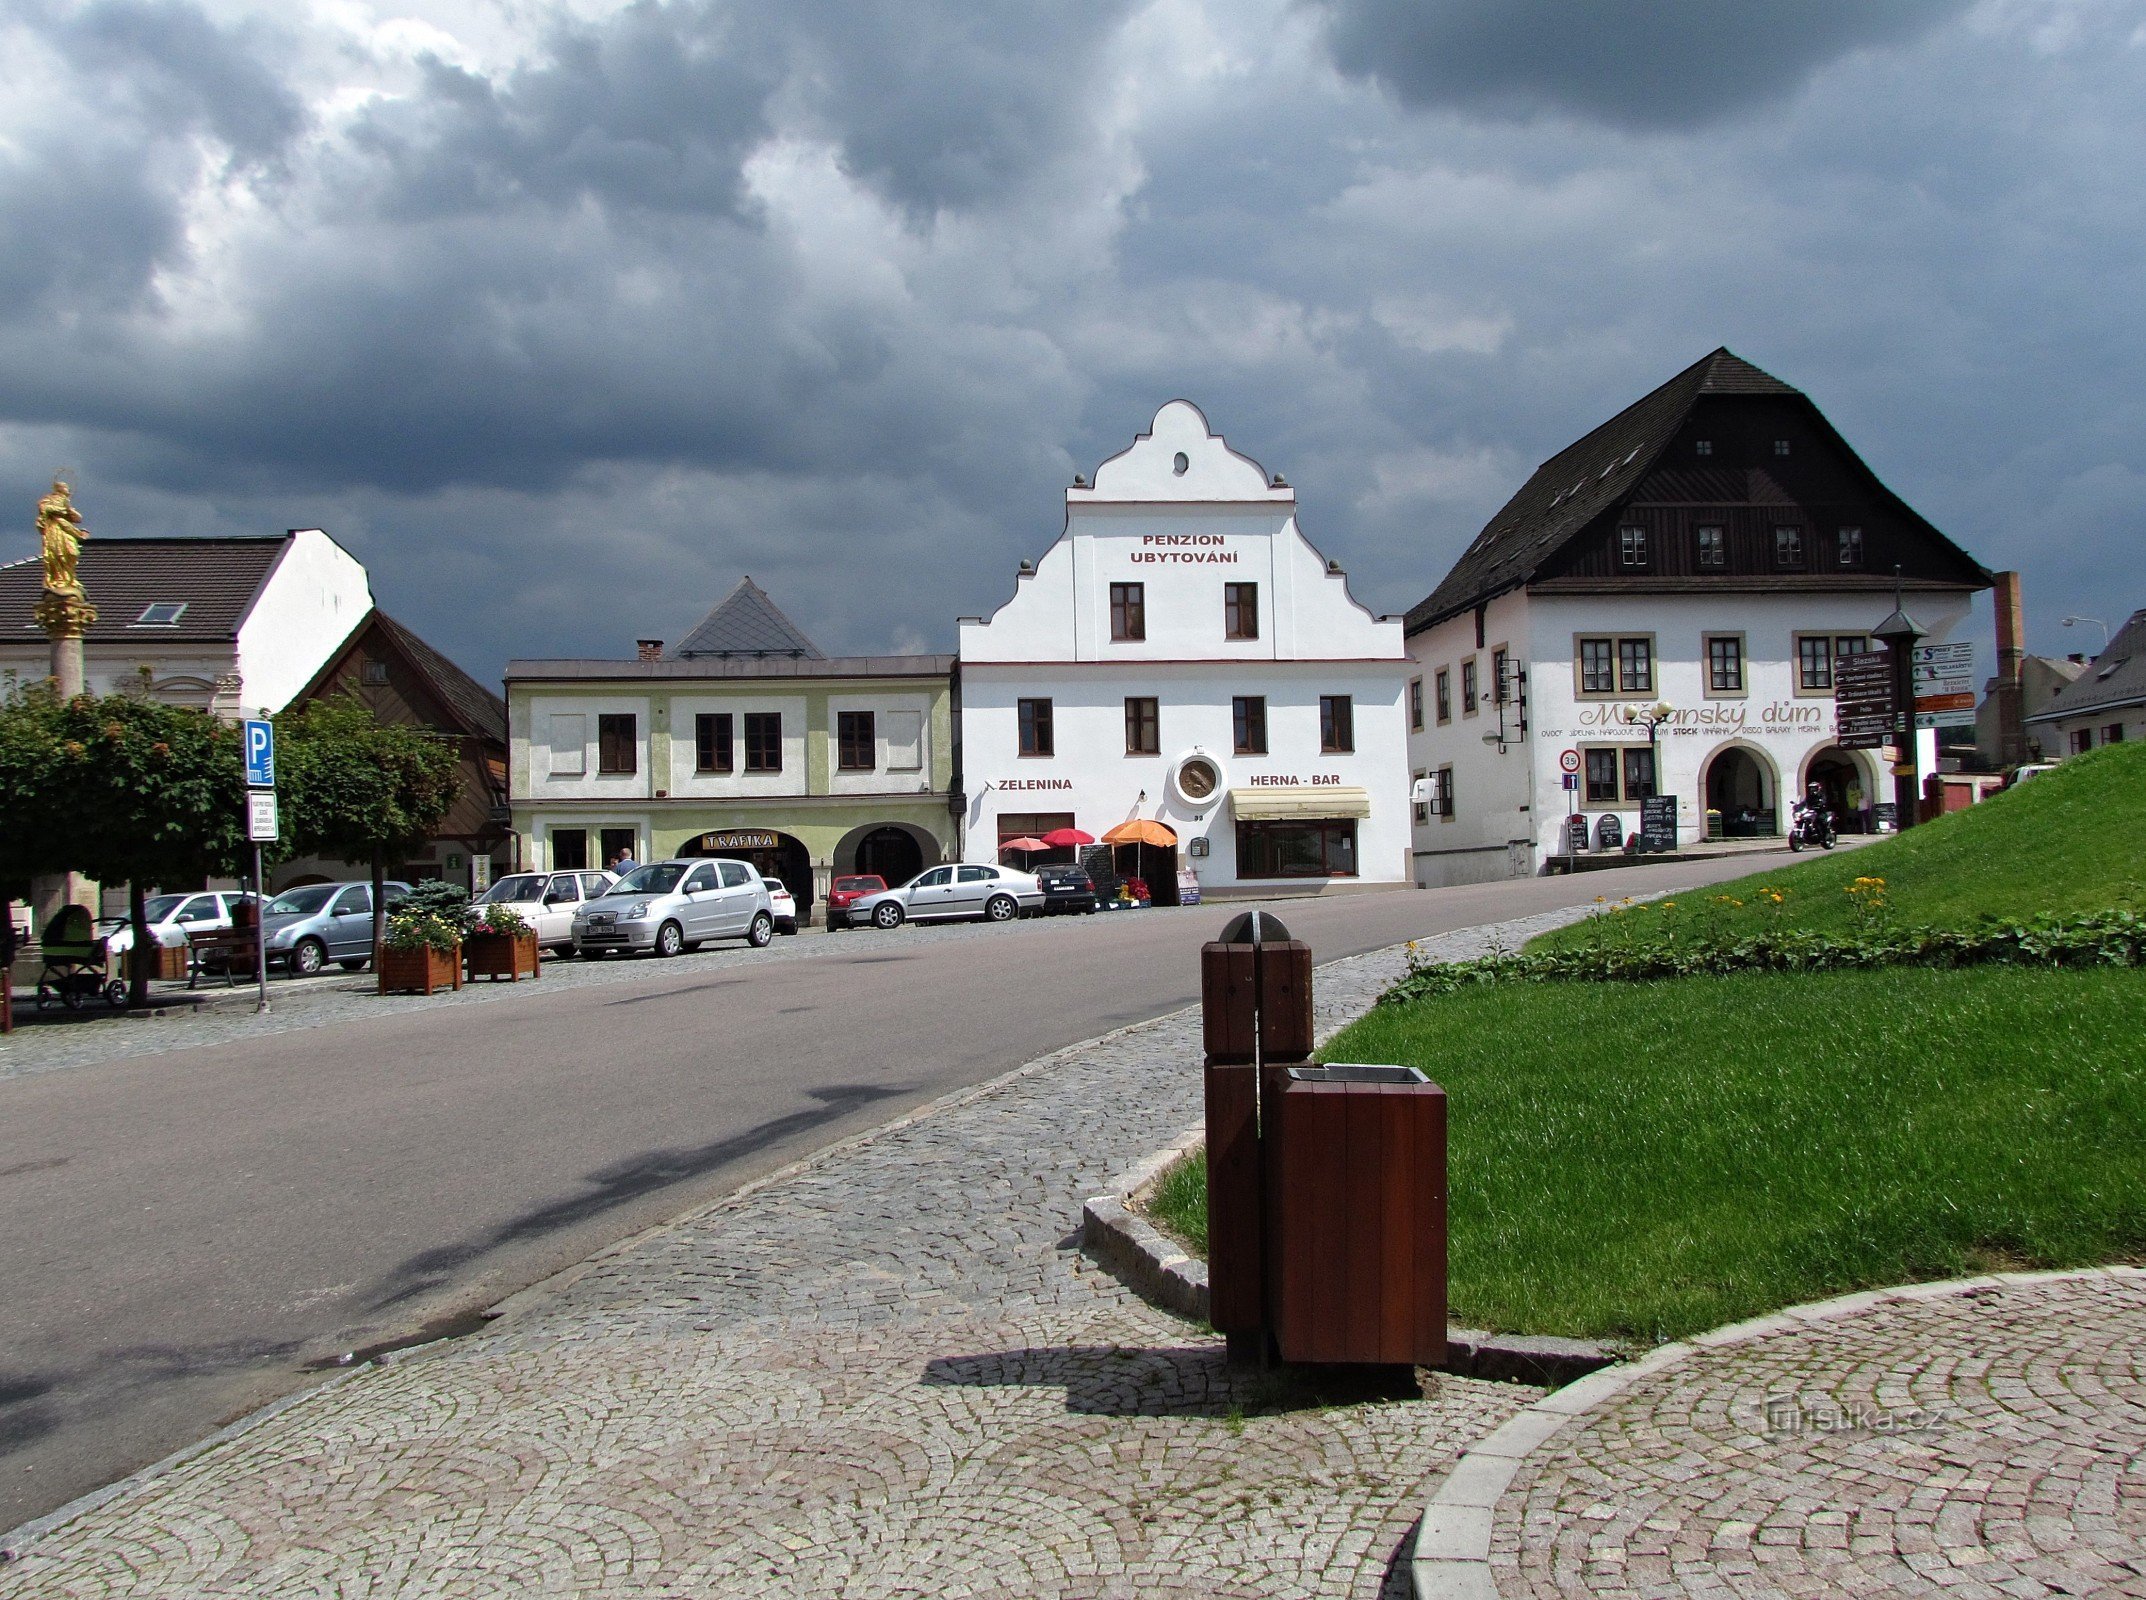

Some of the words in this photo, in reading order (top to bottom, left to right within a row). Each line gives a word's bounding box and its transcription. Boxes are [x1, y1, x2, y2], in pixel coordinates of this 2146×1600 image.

[1143, 535, 1225, 546] PENZION
[1130, 550, 1238, 563] UBYTOVÁNÍ
[1762, 701, 1821, 722] dům
[1599, 726, 1634, 736] NÁPOJOVÉ
[1672, 726, 1698, 735] STOCK
[1702, 725, 1730, 735] VINÁRNA
[1742, 726, 1762, 734] DISCO
[1765, 725, 1791, 734] GALAXY
[1797, 724, 1820, 732] HERNA
[251, 727, 267, 764] P
[998, 779, 1073, 791] ZELENINA
[1250, 775, 1300, 786] HERNA
[1312, 774, 1341, 785] BAR
[707, 834, 774, 849] TRAFIKA
